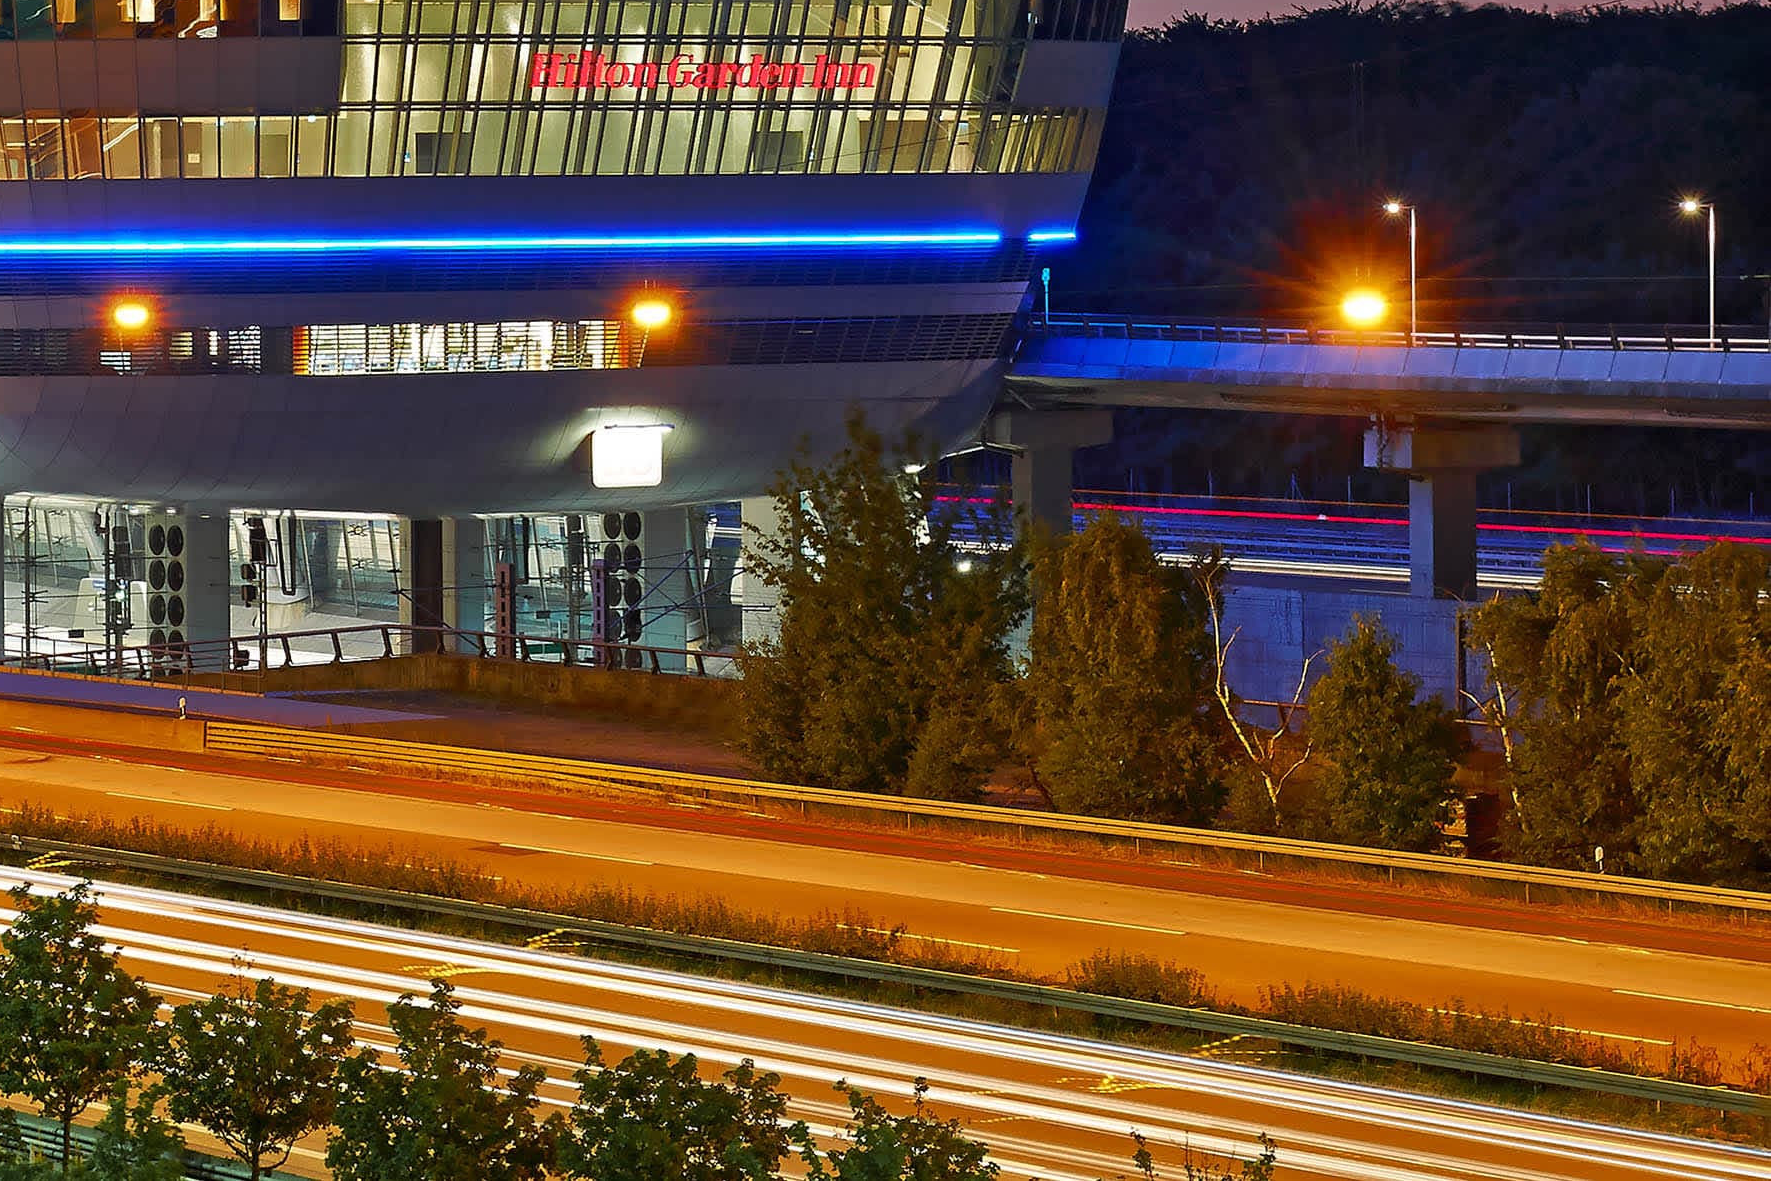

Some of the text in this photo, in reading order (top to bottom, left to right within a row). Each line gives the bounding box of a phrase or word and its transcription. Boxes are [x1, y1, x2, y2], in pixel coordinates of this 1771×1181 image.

[529, 50, 875, 90] Hilton Garden Inn
